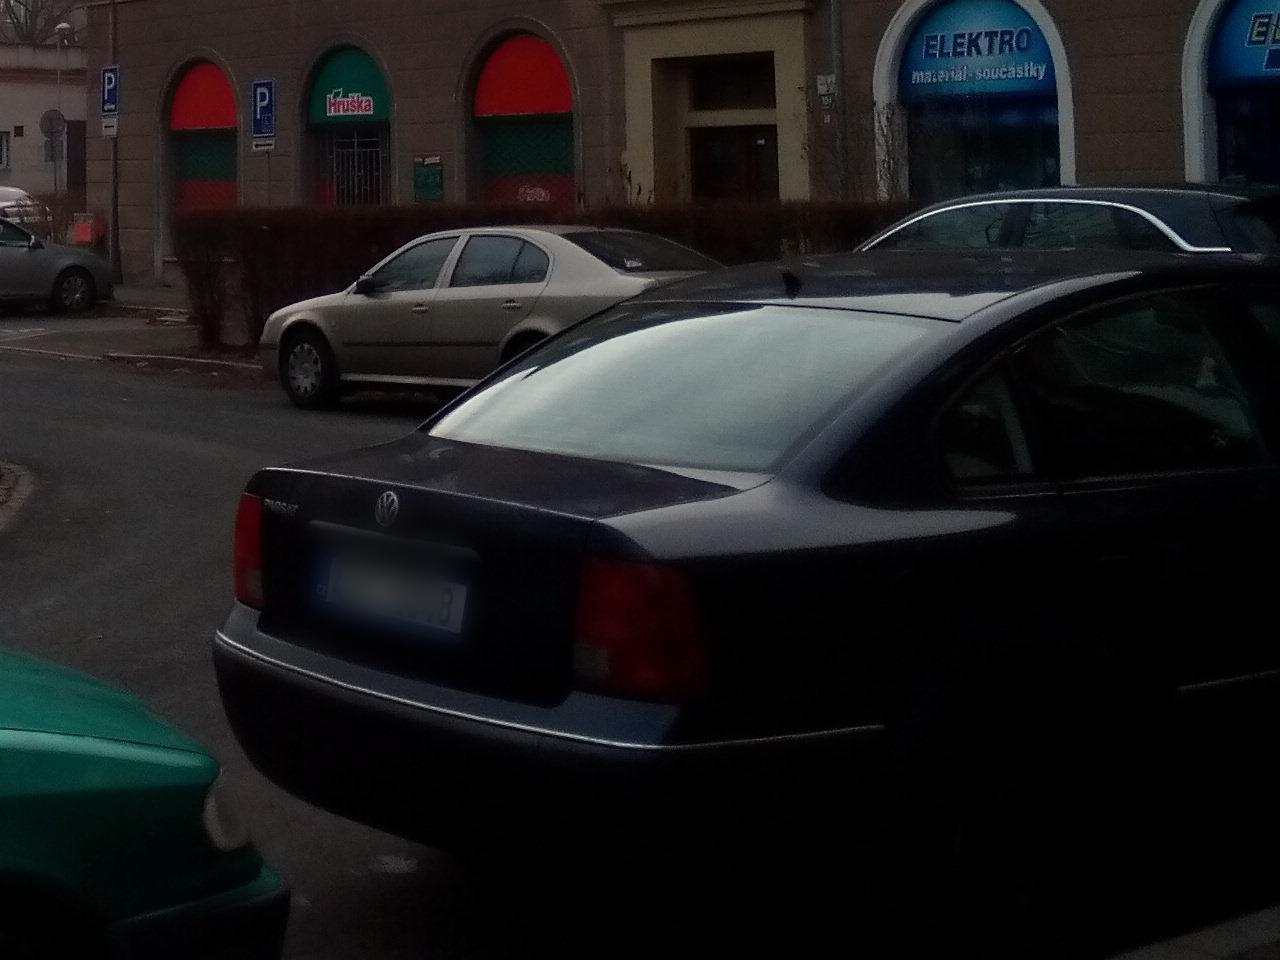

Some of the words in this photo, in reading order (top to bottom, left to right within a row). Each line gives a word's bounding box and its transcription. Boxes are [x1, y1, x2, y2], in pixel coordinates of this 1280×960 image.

[924, 28, 1032, 58] ELEKTRO
[104, 72, 115, 100] P
[256, 87, 269, 119] P
[328, 94, 373, 114] Hruška
